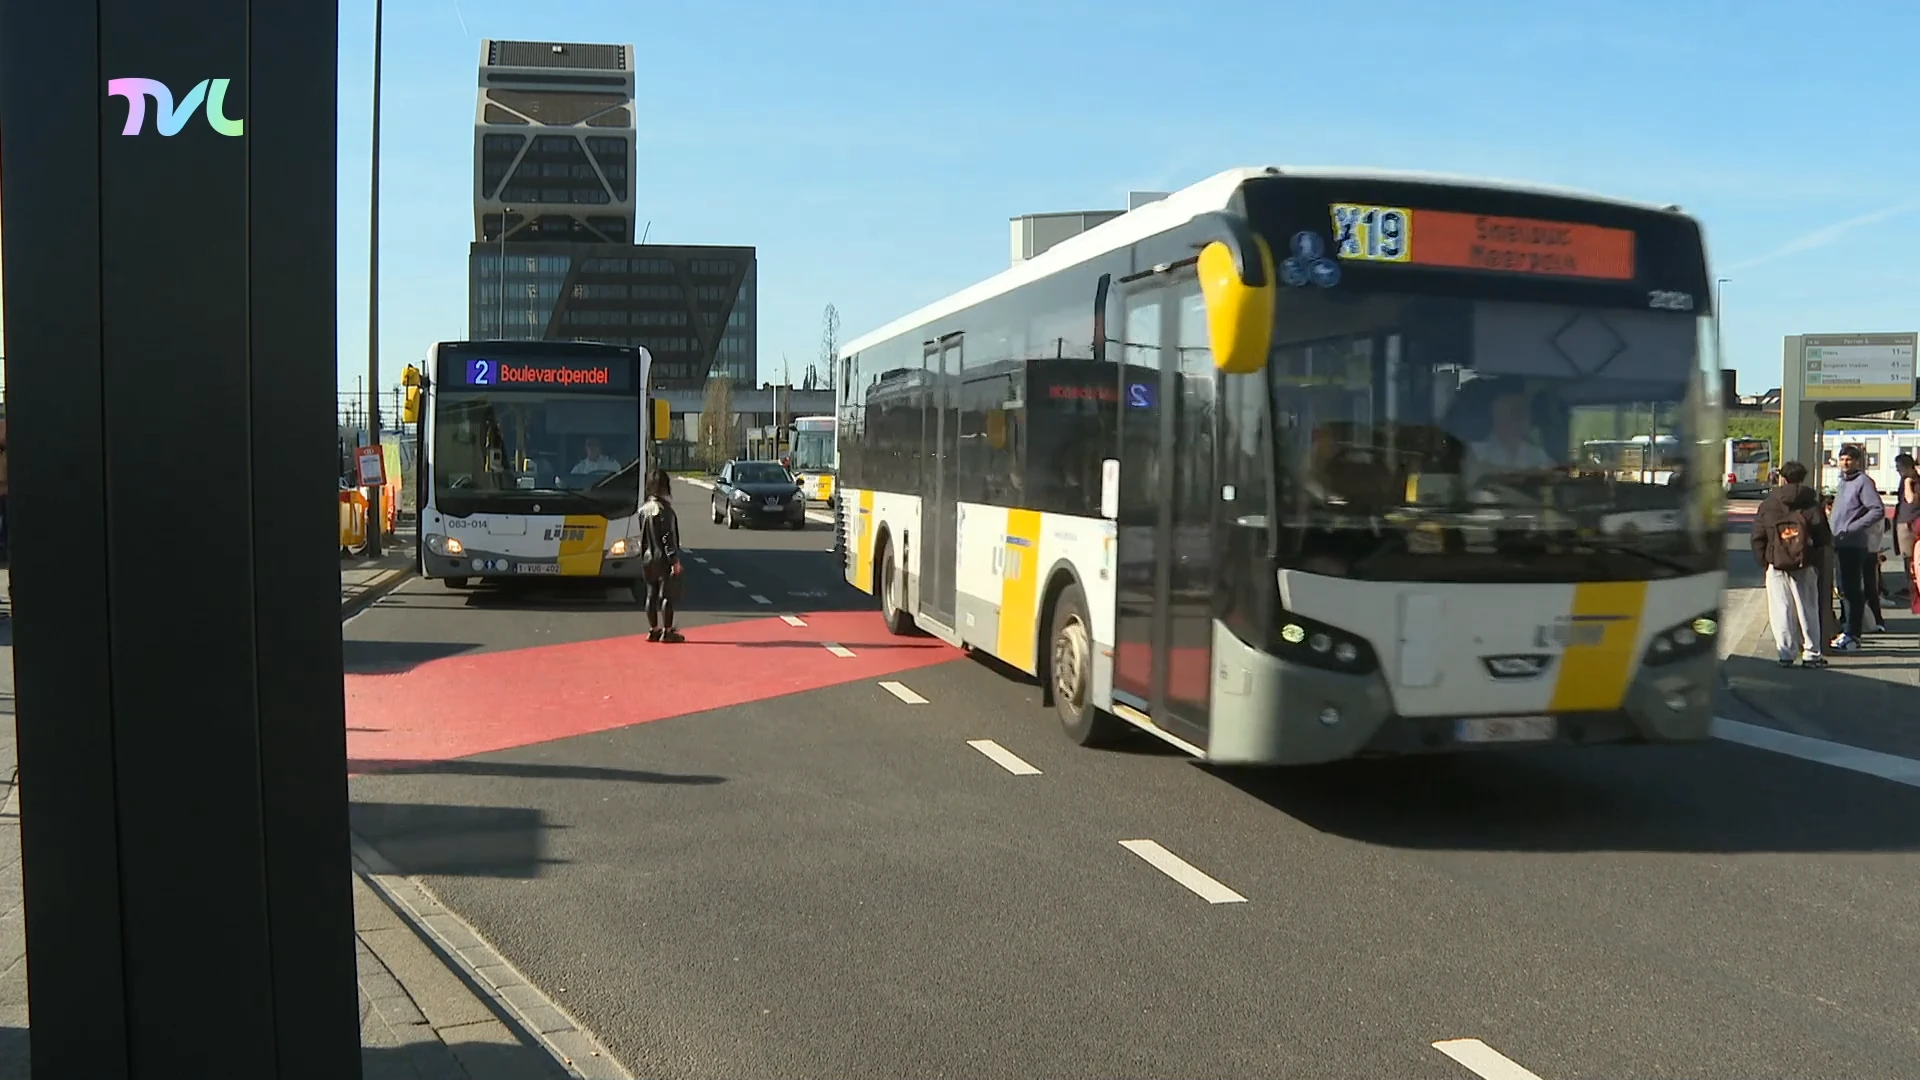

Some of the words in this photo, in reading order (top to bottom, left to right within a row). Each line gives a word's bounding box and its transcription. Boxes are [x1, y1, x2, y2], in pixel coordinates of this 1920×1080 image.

[1335, 207, 1406, 258] X19
[475, 360, 488, 385] 2
[501, 364, 608, 386] Boulevardpendel
